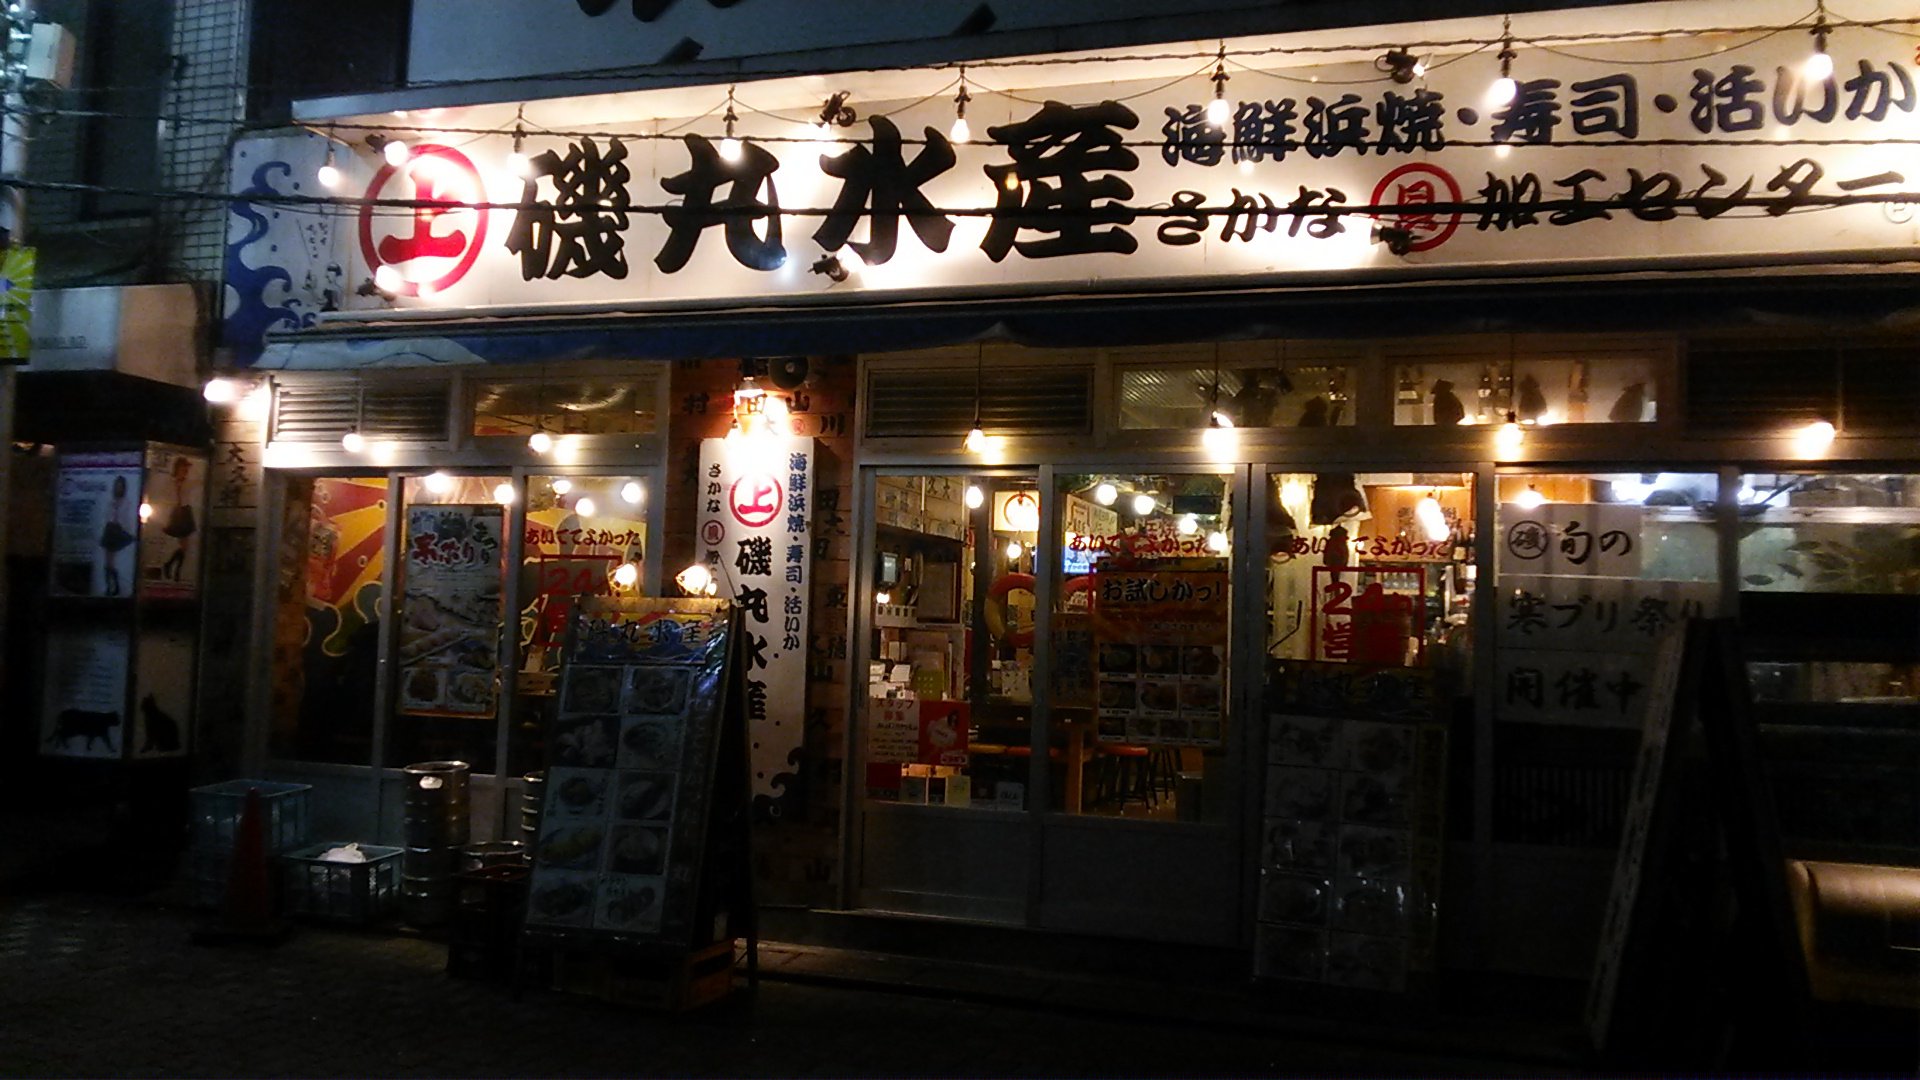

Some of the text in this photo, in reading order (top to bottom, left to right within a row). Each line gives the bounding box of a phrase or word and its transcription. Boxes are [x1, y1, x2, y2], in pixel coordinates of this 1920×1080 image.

[1161, 59, 1917, 166] 海鮮浜焼・寿司・活いか
[504, 100, 1140, 281] 磯丸水産
[1157, 188, 1347, 246] さかな
[1476, 157, 1906, 232] 加工センター
[706, 463, 721, 513] さかな
[524, 527, 641, 546] あいててよかった
[1291, 536, 1449, 556] あいてよかった
[1559, 520, 1632, 565] 旬の
[1507, 665, 1647, 715] 開催中
